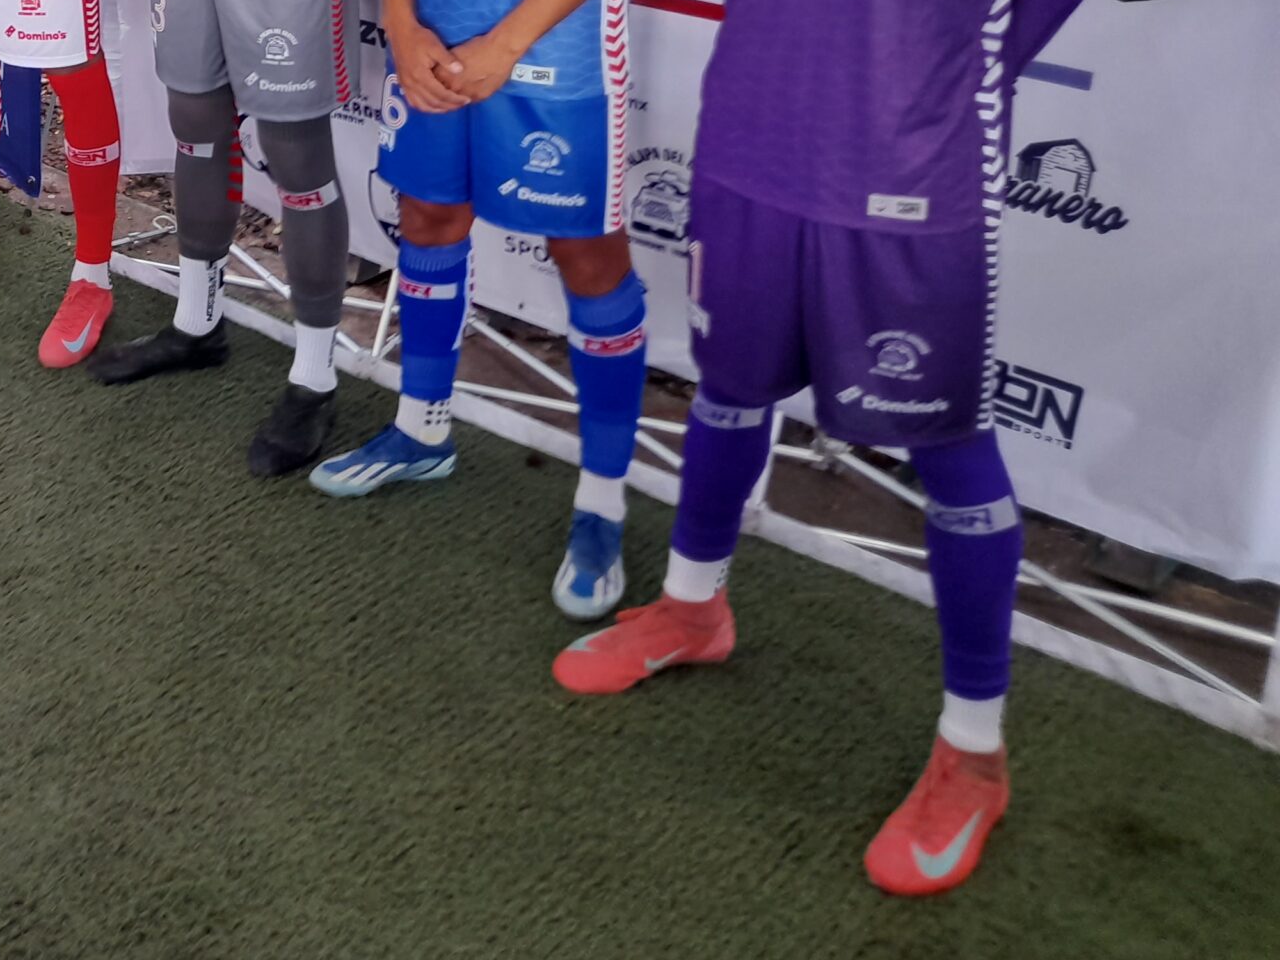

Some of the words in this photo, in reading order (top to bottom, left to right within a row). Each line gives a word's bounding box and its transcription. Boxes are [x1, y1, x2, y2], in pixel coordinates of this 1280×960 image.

[17, 30, 67, 41] Domino's
[259, 76, 317, 92] Domino's
[517, 185, 588, 208] Domino's
[1004, 175, 1130, 235] ranero
